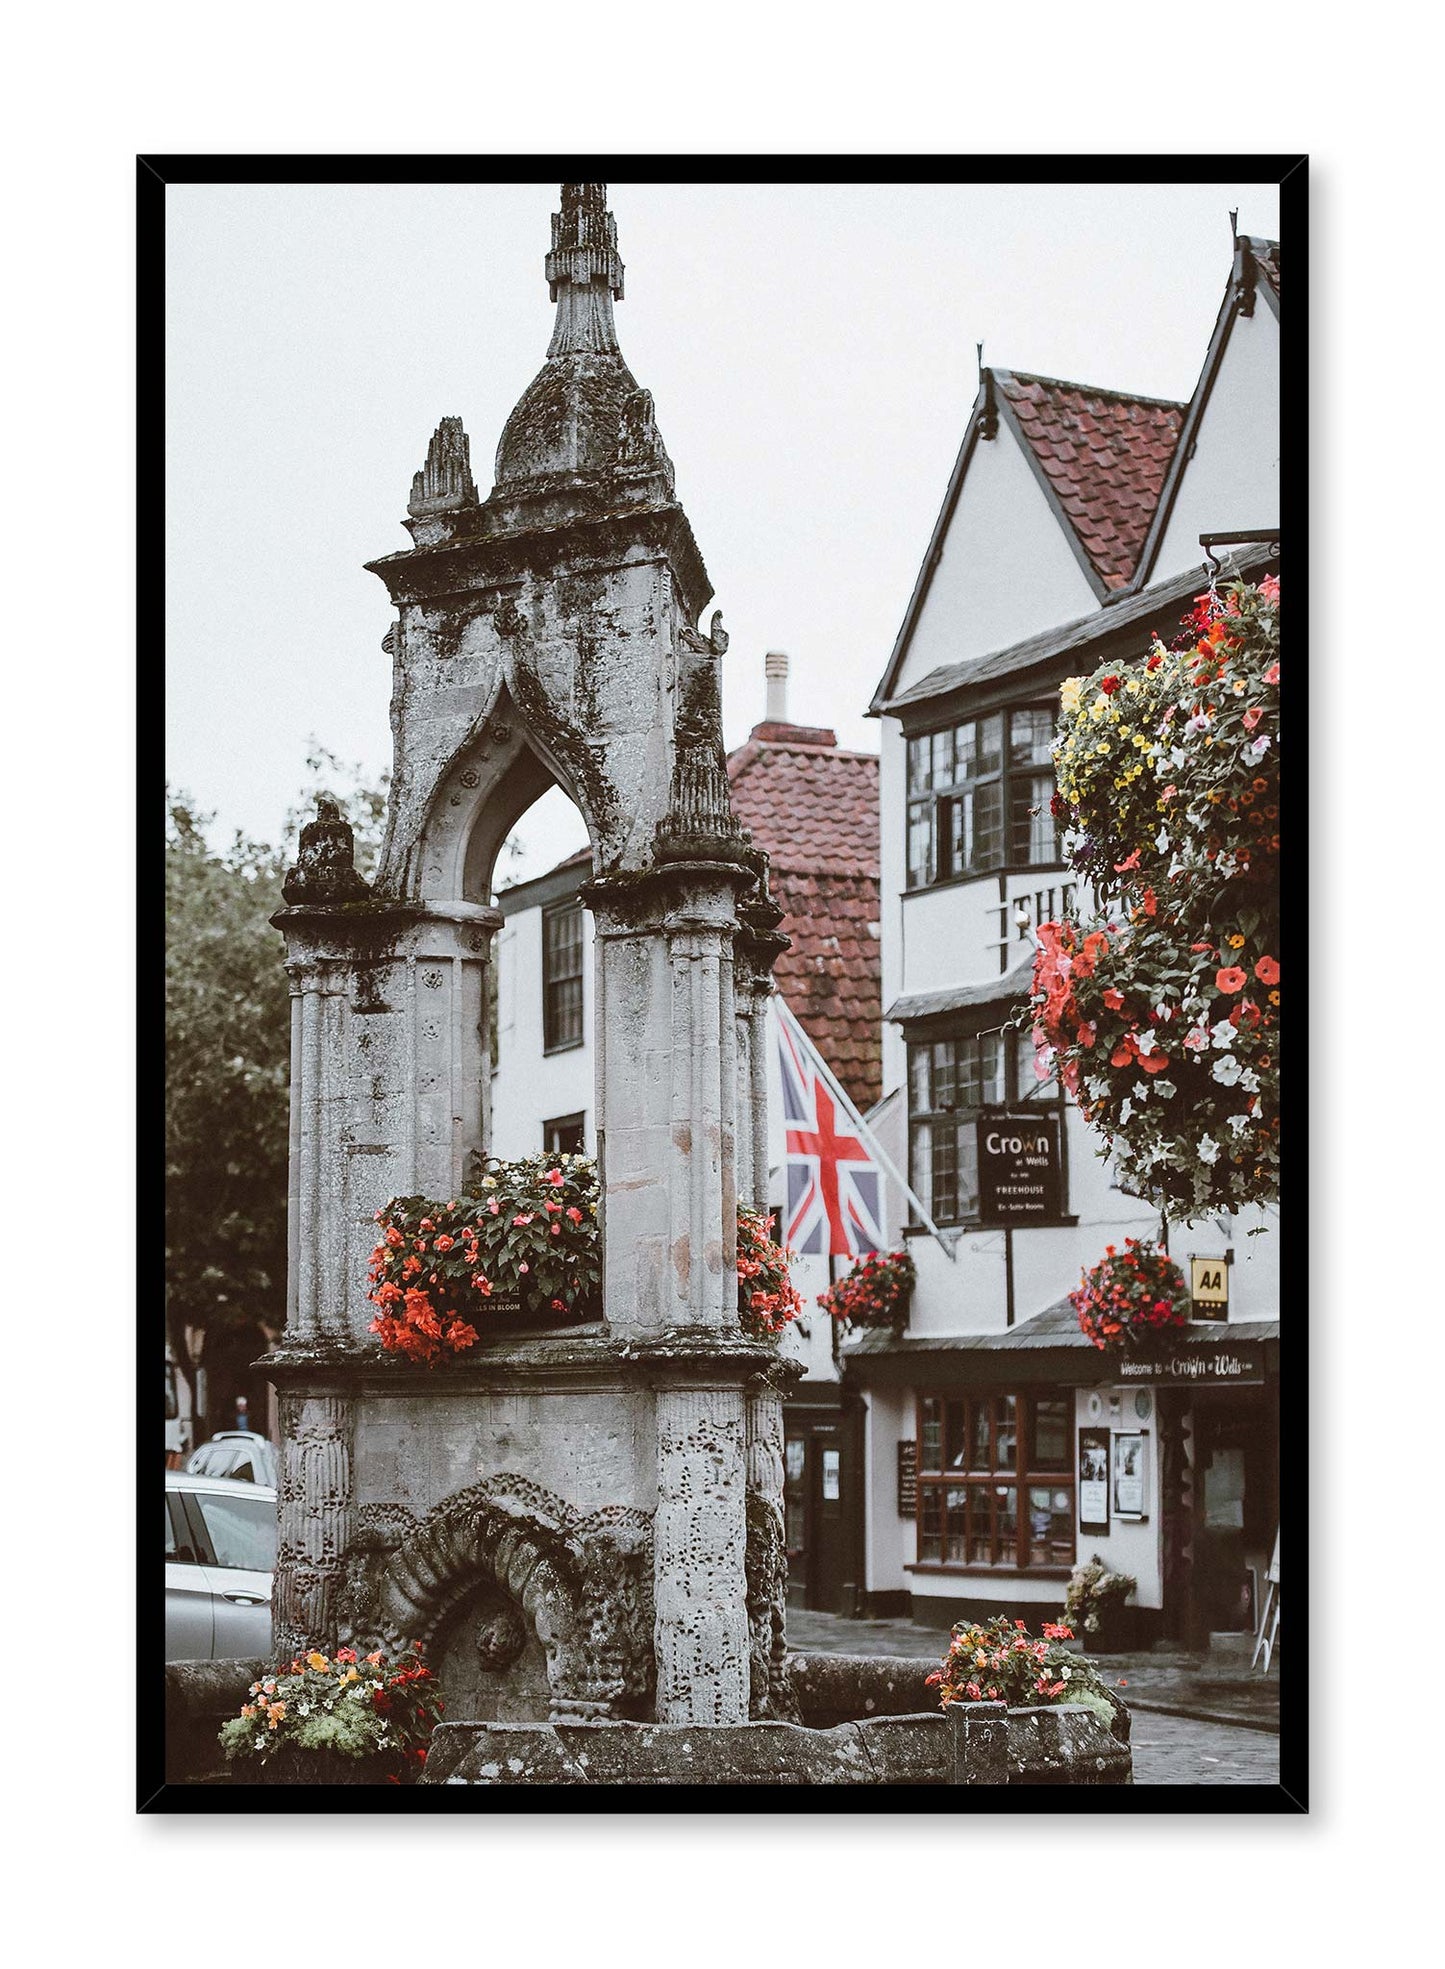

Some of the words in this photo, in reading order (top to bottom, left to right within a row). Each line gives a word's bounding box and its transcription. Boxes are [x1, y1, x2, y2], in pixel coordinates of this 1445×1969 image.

[986, 1131, 1049, 1154] Crown
[1025, 1156, 1049, 1167] Wells
[996, 1186, 1045, 1195] FREEHOUSE
[1200, 1270, 1221, 1290] AA
[497, 1303, 520, 1311] BLOOM
[1120, 1361, 1153, 1376] Welcome
[1155, 1362, 1162, 1375] to
[1171, 1355, 1206, 1378] Crown
[1214, 1354, 1241, 1376] Wells
